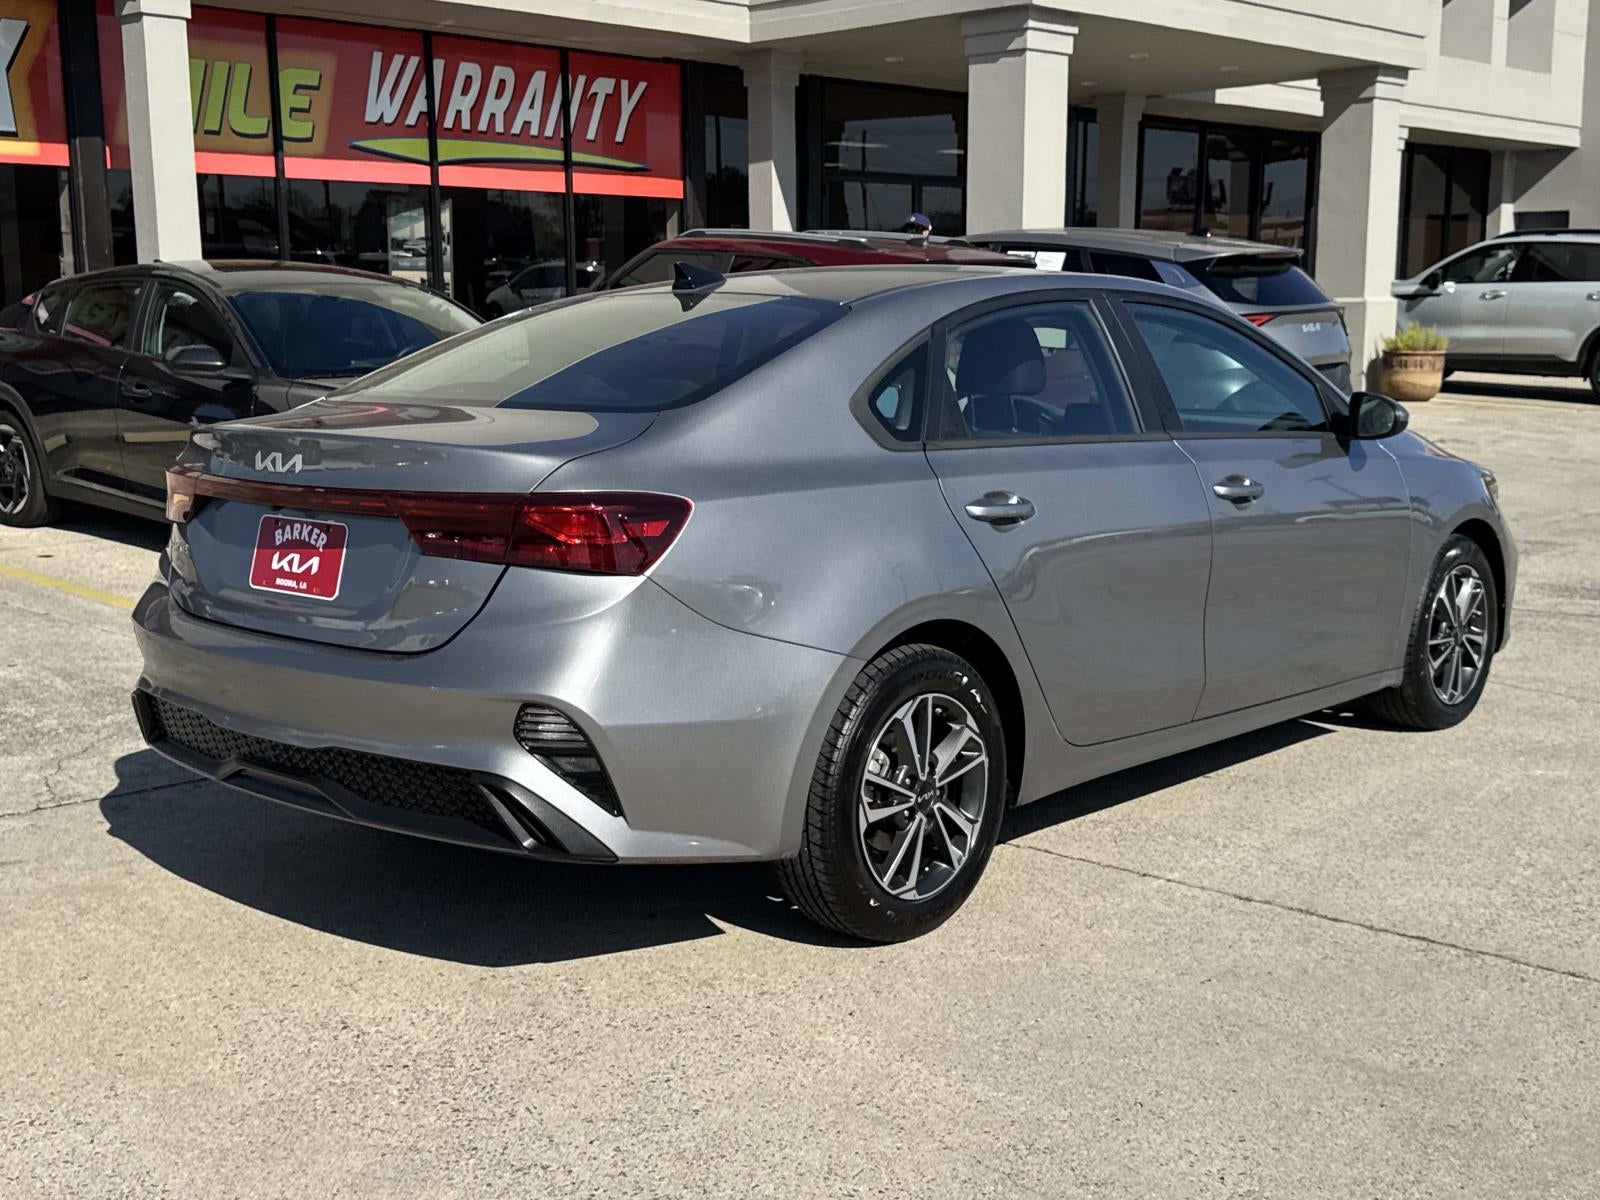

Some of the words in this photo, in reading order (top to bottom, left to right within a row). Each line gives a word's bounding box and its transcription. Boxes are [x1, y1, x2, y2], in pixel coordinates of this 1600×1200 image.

[364, 50, 648, 143] WARRANTY
[255, 450, 303, 474] KIA
[274, 523, 328, 552] BARKER
[271, 551, 320, 576] KIA
